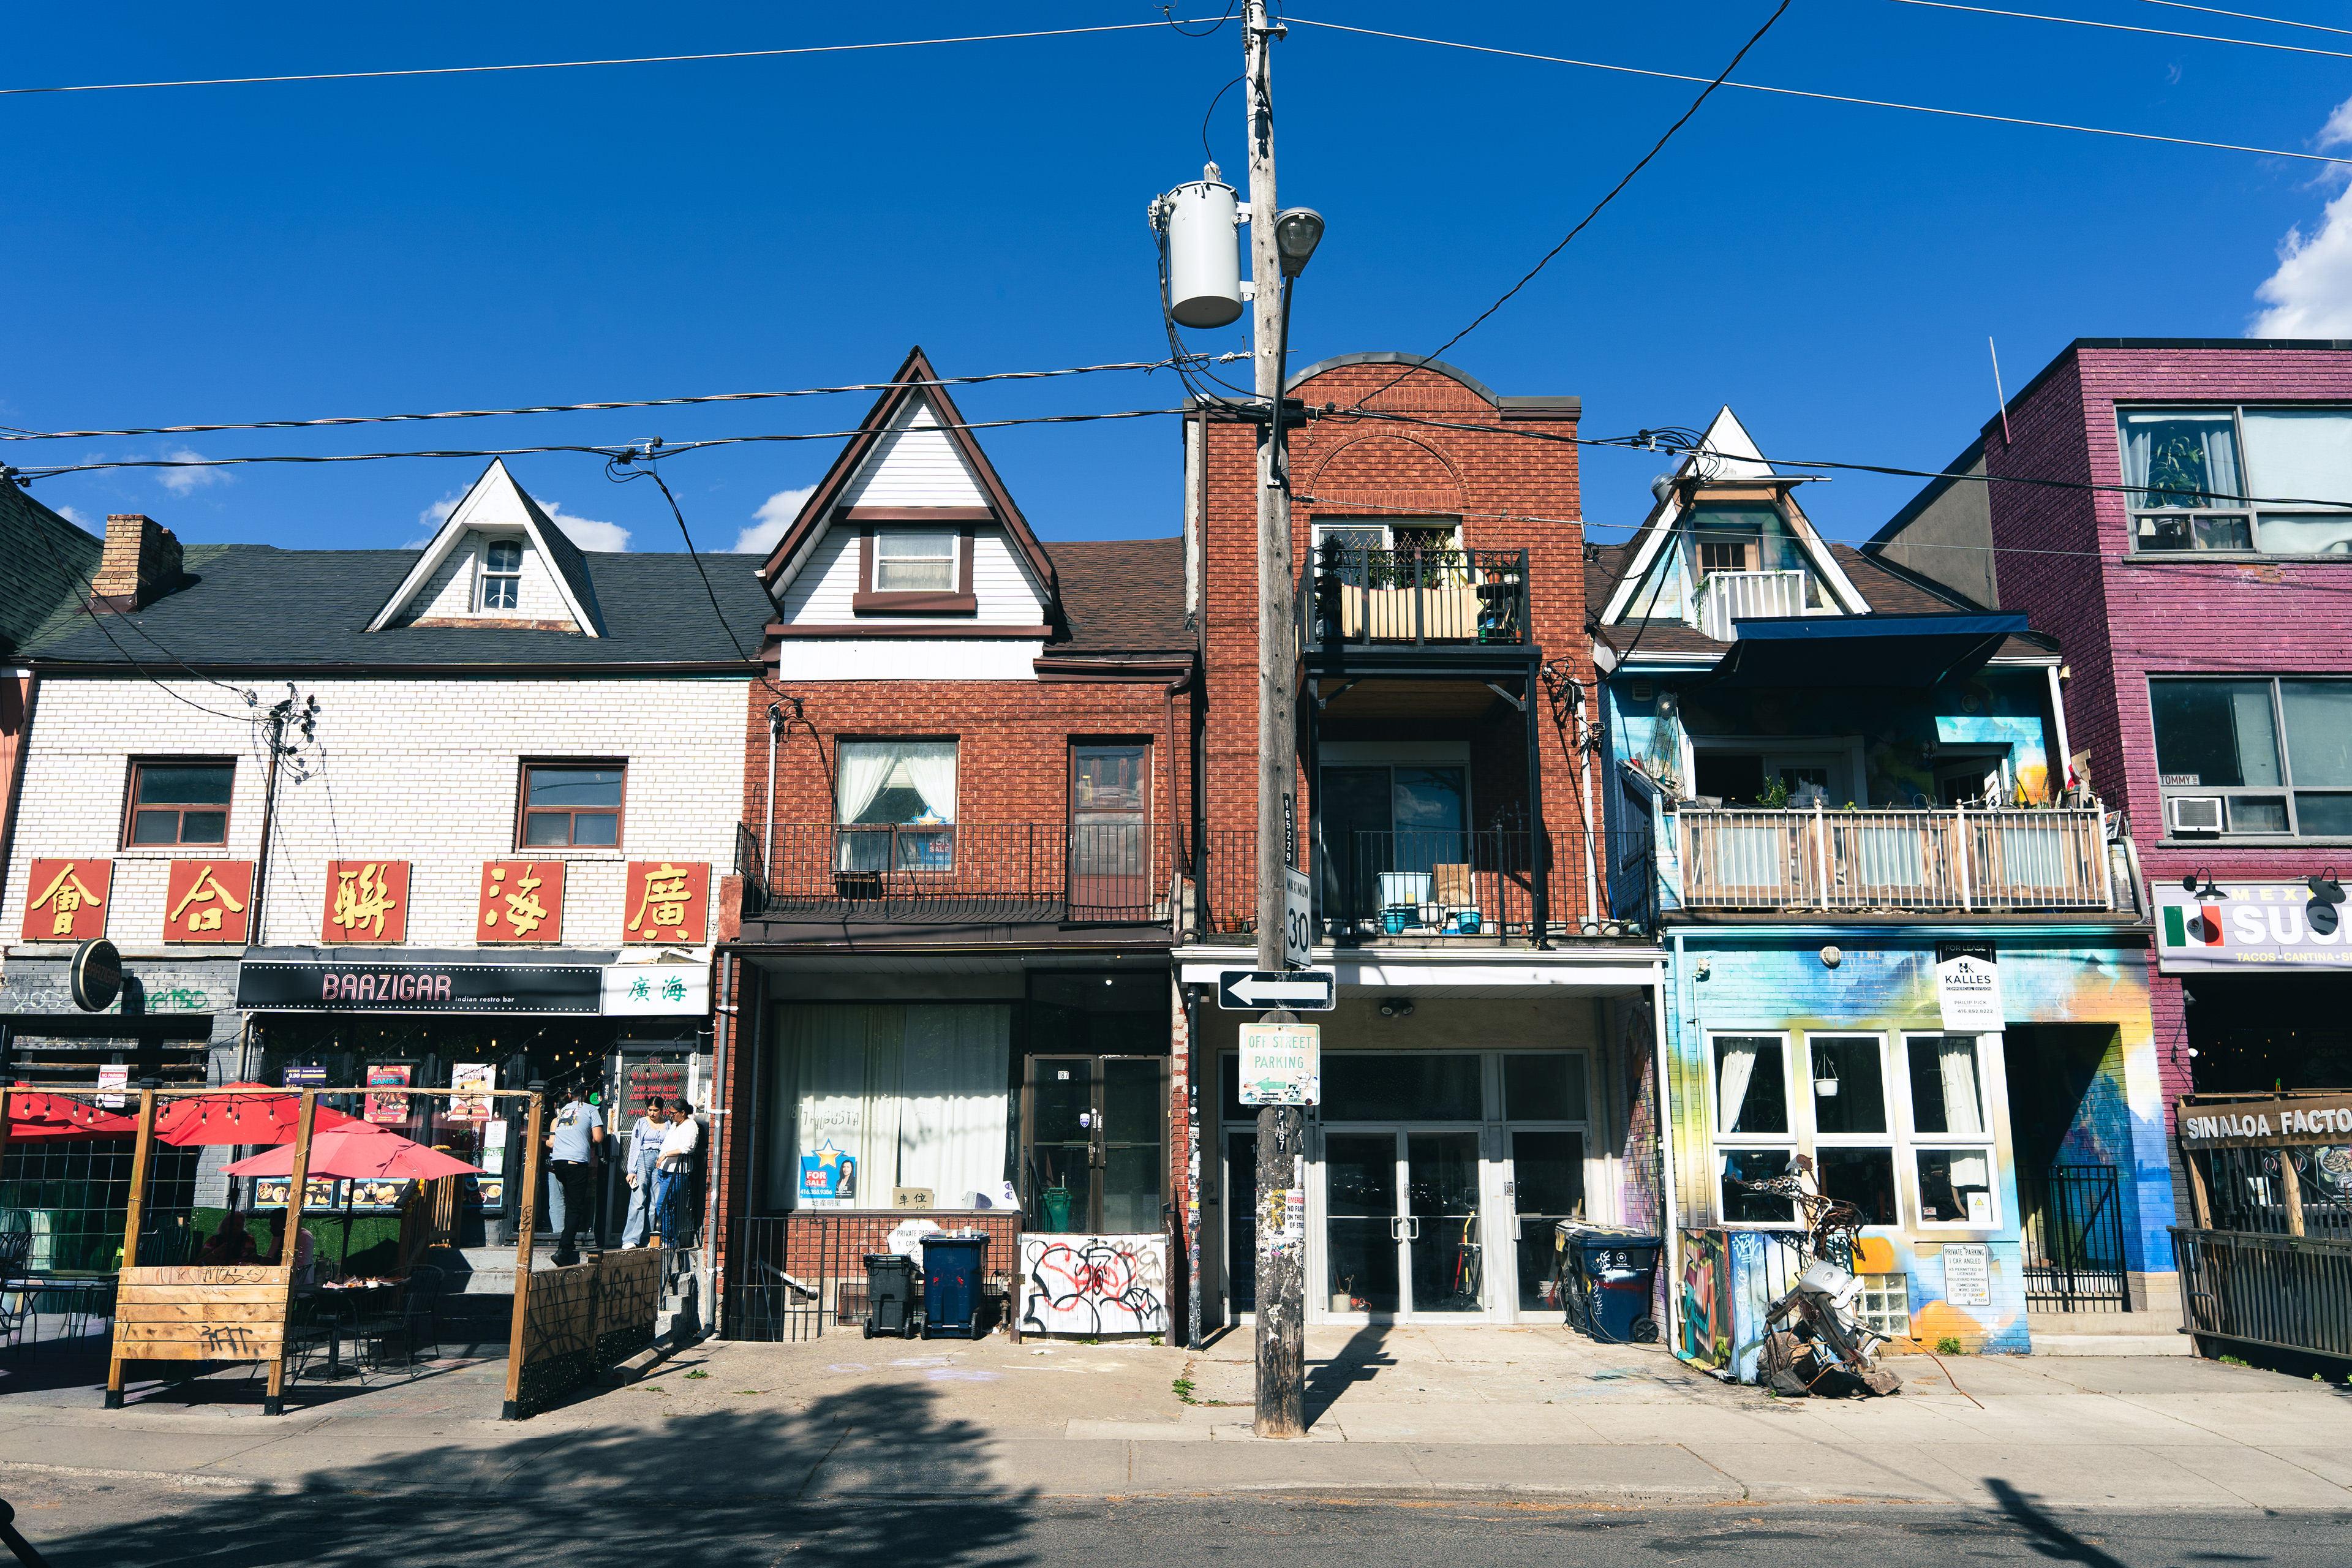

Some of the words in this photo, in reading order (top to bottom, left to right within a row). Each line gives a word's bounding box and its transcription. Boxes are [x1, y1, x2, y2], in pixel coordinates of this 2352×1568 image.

[2160, 775, 2190, 785] TOMMY
[1287, 877, 1308, 899] MAXIMUM
[31, 863, 102, 935] 會
[170, 864, 244, 932] 合
[485, 864, 548, 937] 海
[1288, 907, 1308, 952] 30
[2236, 952, 2276, 962] TACOS
[2284, 952, 2335, 962] CANTINA
[322, 973, 452, 1001] BAAZIGAR
[628, 975, 688, 1003] 廣海
[1945, 975, 1991, 984] KALLES
[1249, 1036, 1266, 1048] OFF
[1273, 1036, 1312, 1049] STREET
[1254, 1056, 1303, 1069] PARKING
[2187, 1114, 2272, 1139] SINALOA
